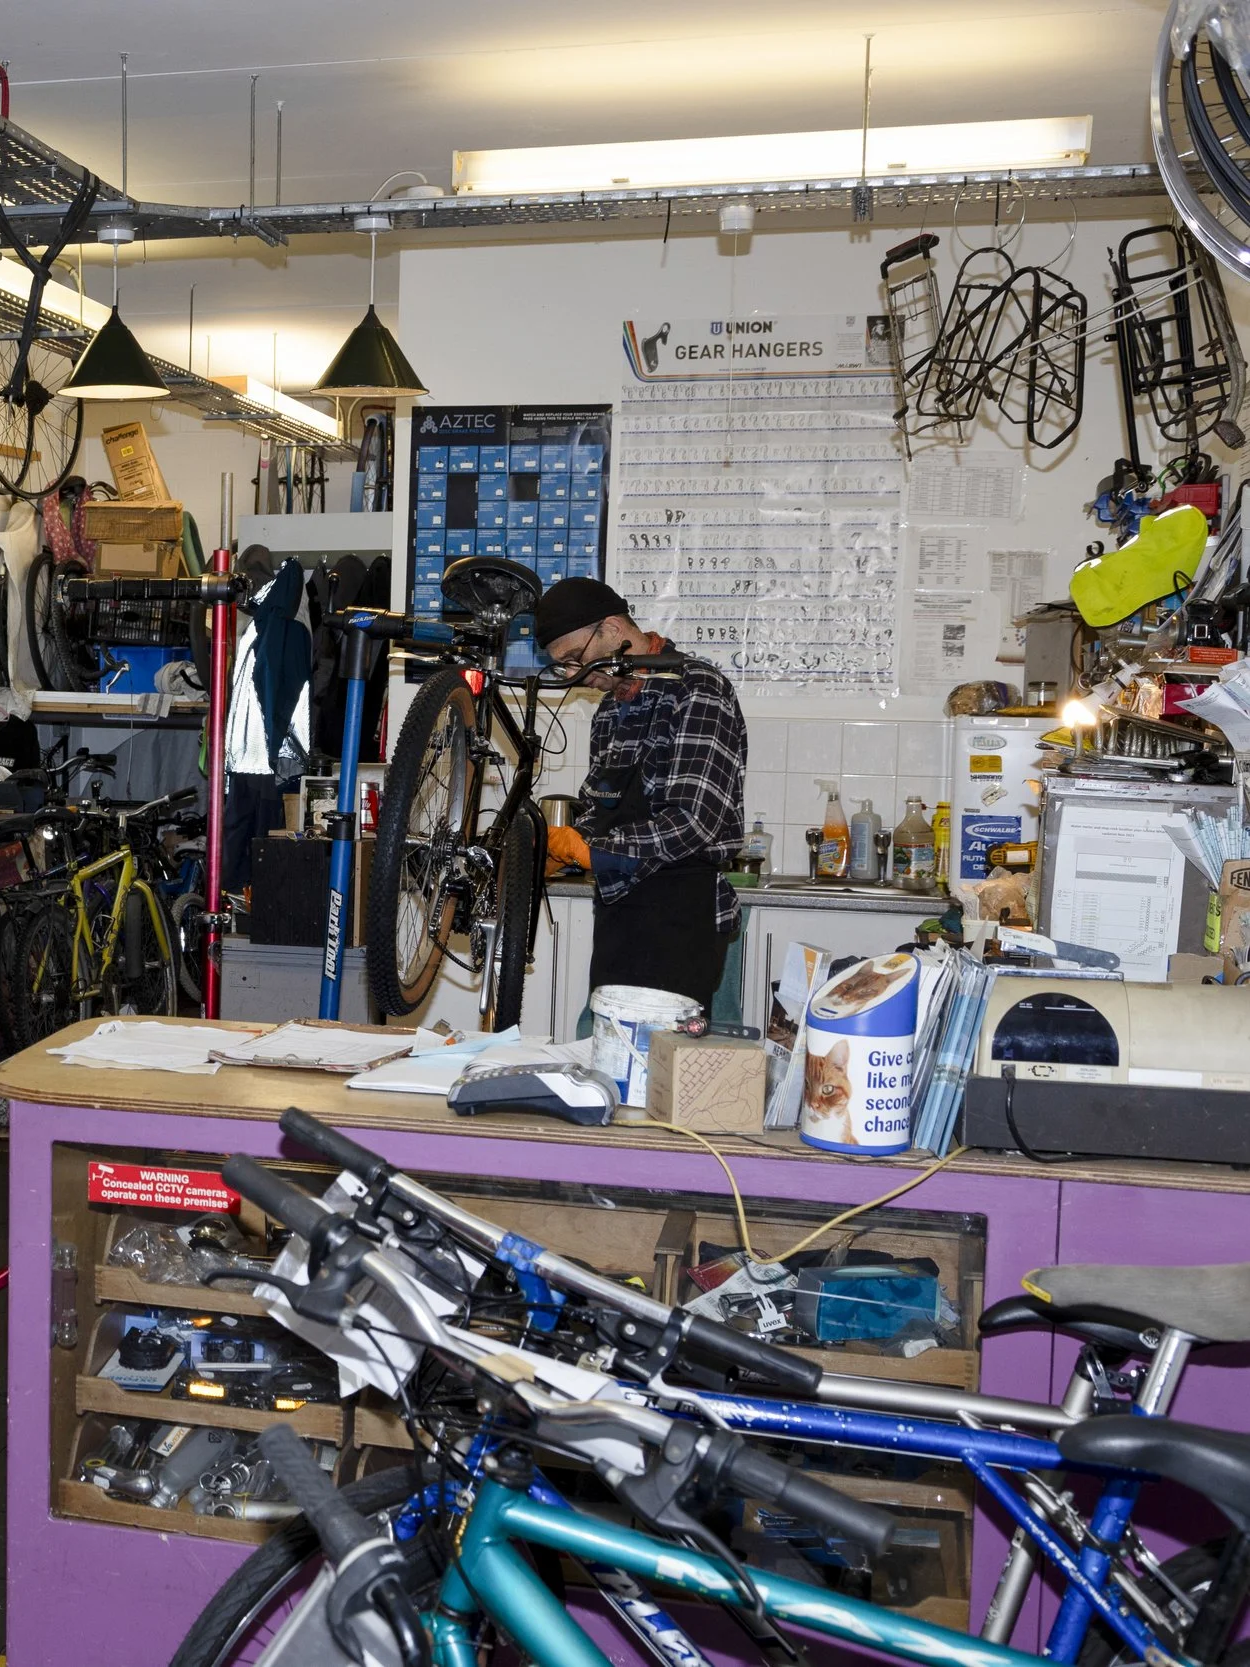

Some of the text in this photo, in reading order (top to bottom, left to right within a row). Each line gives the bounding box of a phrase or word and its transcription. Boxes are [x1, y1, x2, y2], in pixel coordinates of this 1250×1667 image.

[726, 320, 773, 334] UNION
[675, 342, 824, 360] GEAR HANGERS
[440, 414, 496, 428] AZTEC
[106, 429, 139, 445] challenge
[868, 1050, 904, 1068] Give
[867, 1072, 897, 1089] like
[140, 1170, 190, 1184] WARNING
[102, 1178, 228, 1199] Concealed CCTV cameras
[101, 1190, 229, 1210] operate on these premises
[763, 1318, 782, 1328] uvex
